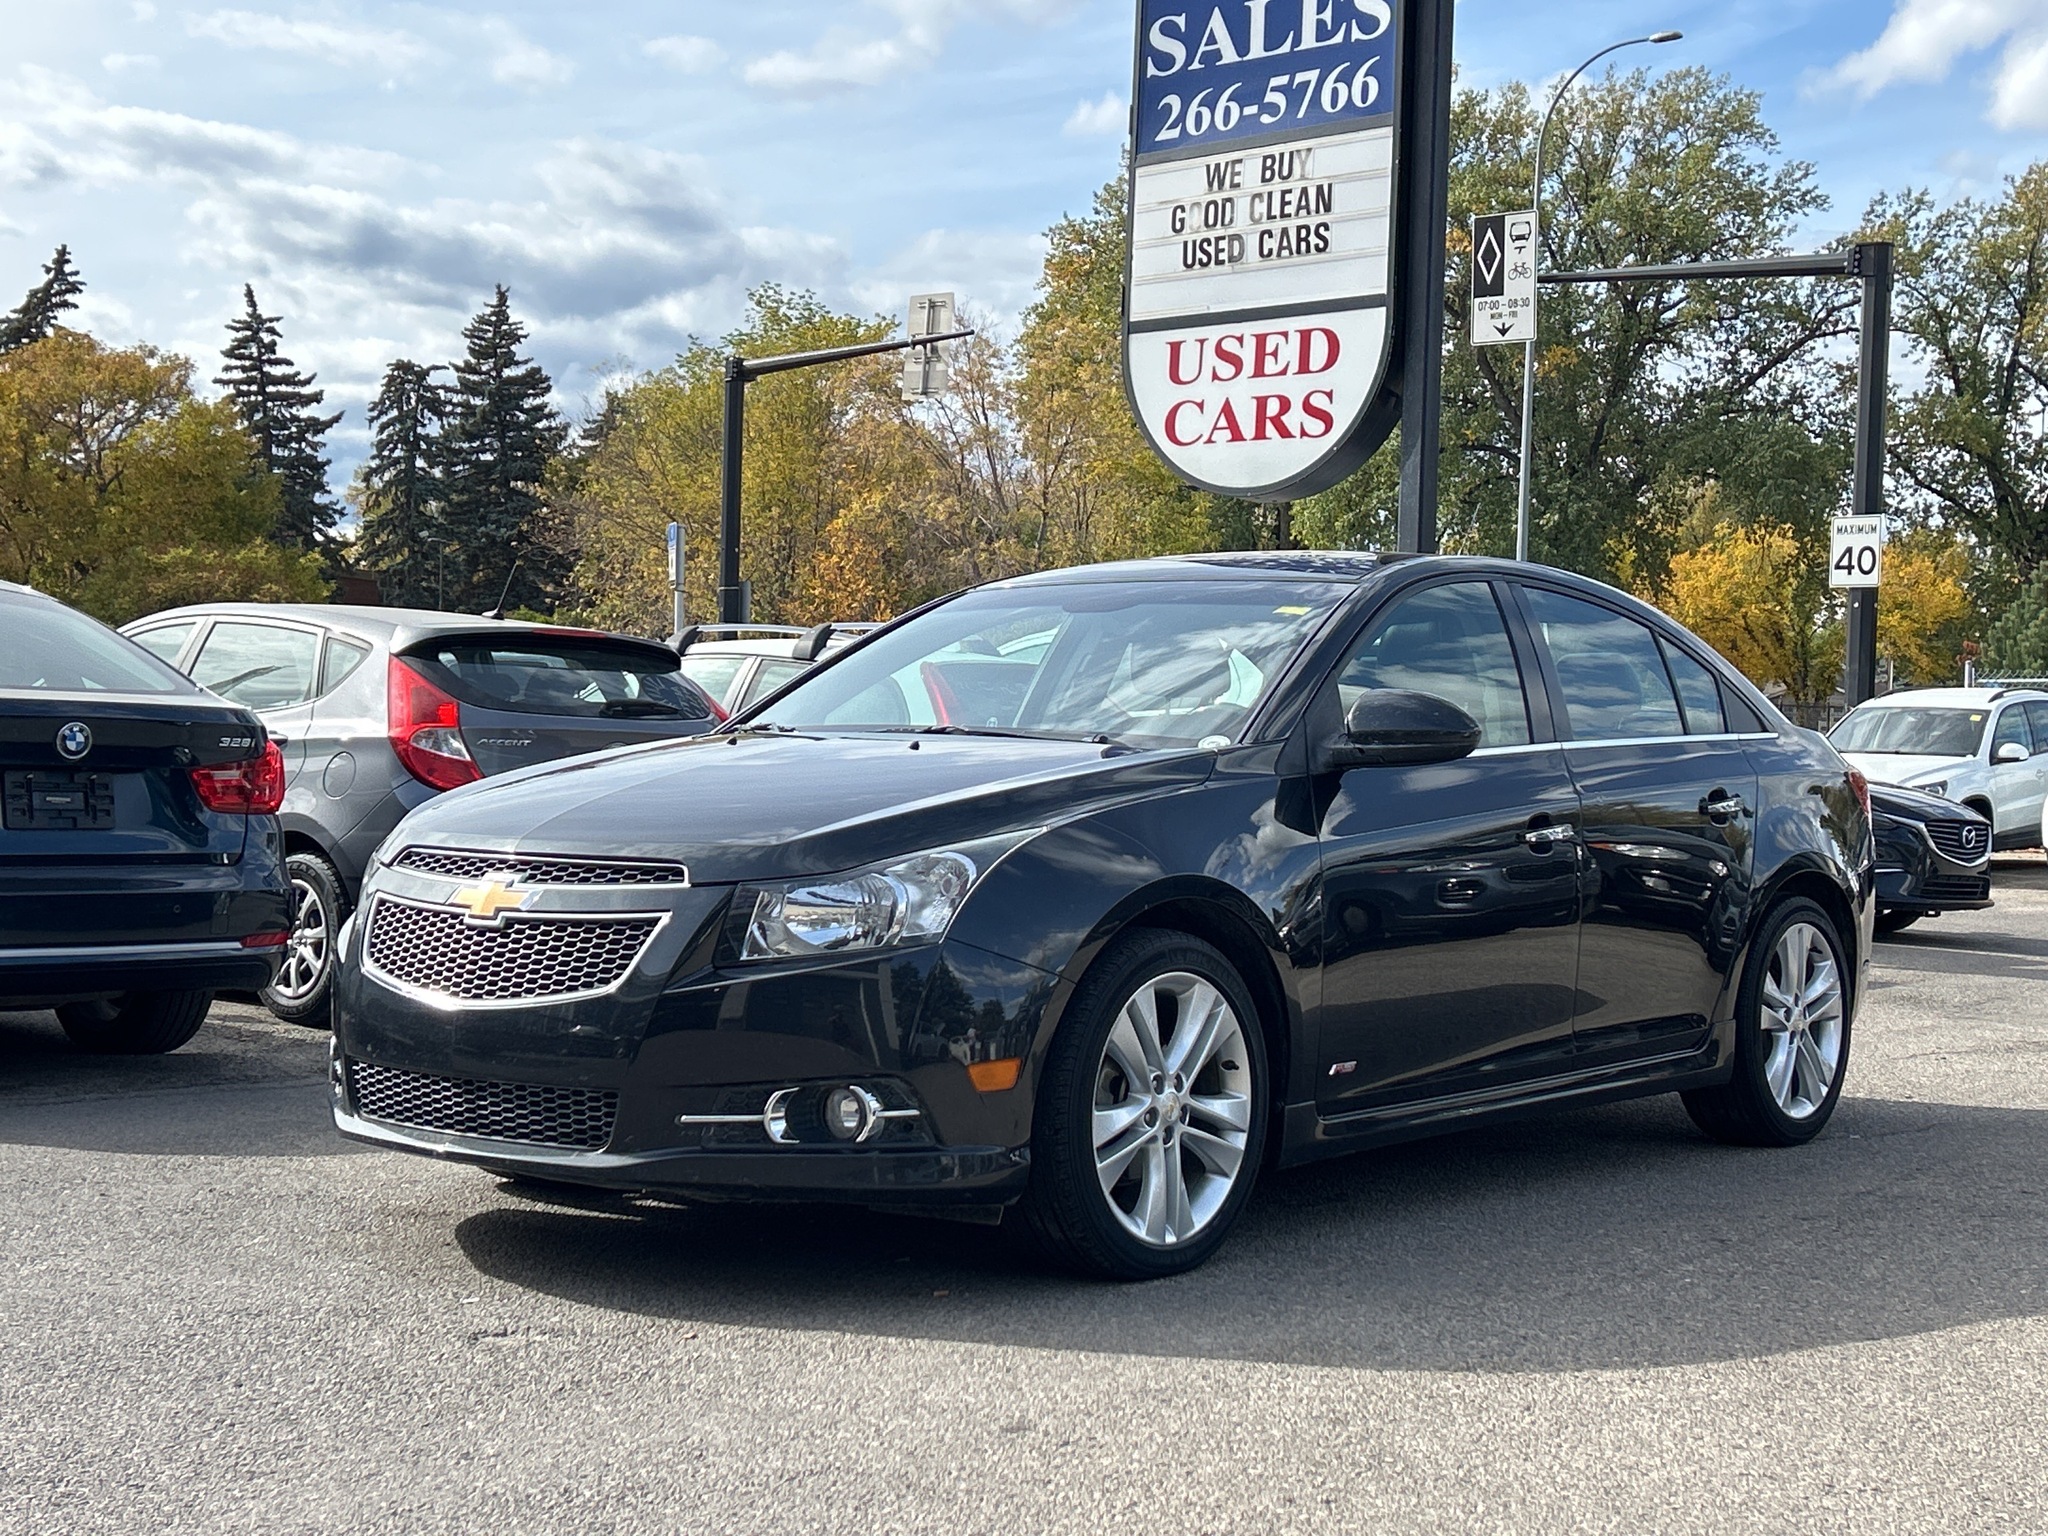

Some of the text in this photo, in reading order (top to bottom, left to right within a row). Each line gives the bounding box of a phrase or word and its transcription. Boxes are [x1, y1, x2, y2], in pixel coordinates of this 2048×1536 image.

[1146, 0, 1391, 78] SALES
[1154, 55, 1380, 141] 266-5766
[1205, 147, 1313, 191] WE BUY
[1249, 183, 1333, 224] CLEAN
[1182, 222, 1330, 268] USED CARS
[1165, 327, 1340, 386] USED
[1164, 389, 1334, 447] CARS
[1836, 524, 1877, 535] MAXIMUM
[1834, 545, 1877, 575] 40
[477, 738, 532, 746] ACCENT
